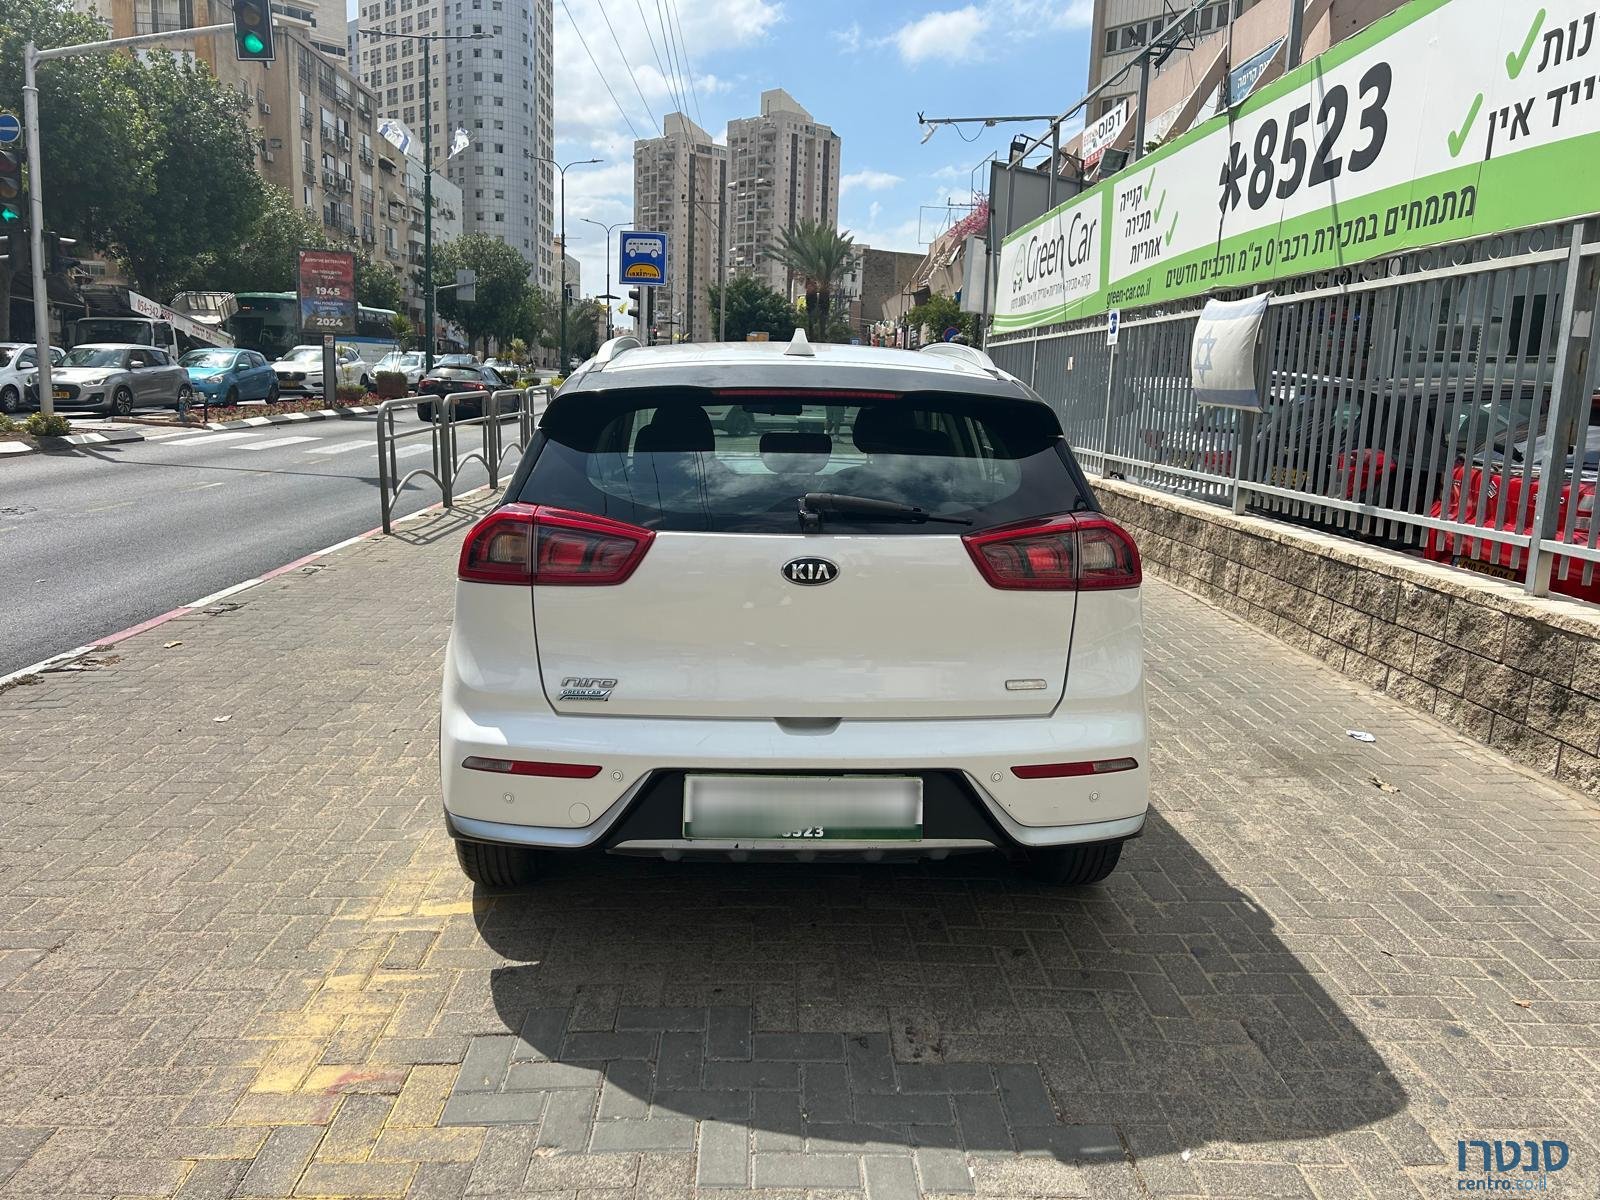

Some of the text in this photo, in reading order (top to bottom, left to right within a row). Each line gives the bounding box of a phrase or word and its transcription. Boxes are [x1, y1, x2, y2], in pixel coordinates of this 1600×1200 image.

[1537, 12, 1600, 73] נות
[1098, 109, 1122, 139] דפוס
[1484, 75, 1600, 162] ייד אין
[1120, 184, 1143, 213] קנייה
[1384, 185, 1477, 237] מתמחים
[1125, 209, 1151, 238] מכירה
[1312, 213, 1378, 256] במכירת
[1026, 211, 1097, 283] Green Car
[1130, 236, 1162, 264] אחריות
[1265, 238, 1275, 266] 0
[1277, 233, 1309, 263] רכבי
[1165, 262, 1198, 288] חדשים
[1200, 252, 1236, 281] ורכבים
[315, 286, 341, 296] 1945
[1106, 277, 1152, 308] green-car.co.il
[316, 318, 344, 327] 2024
[791, 563, 831, 580] KIA
[560, 676, 618, 689] niro
